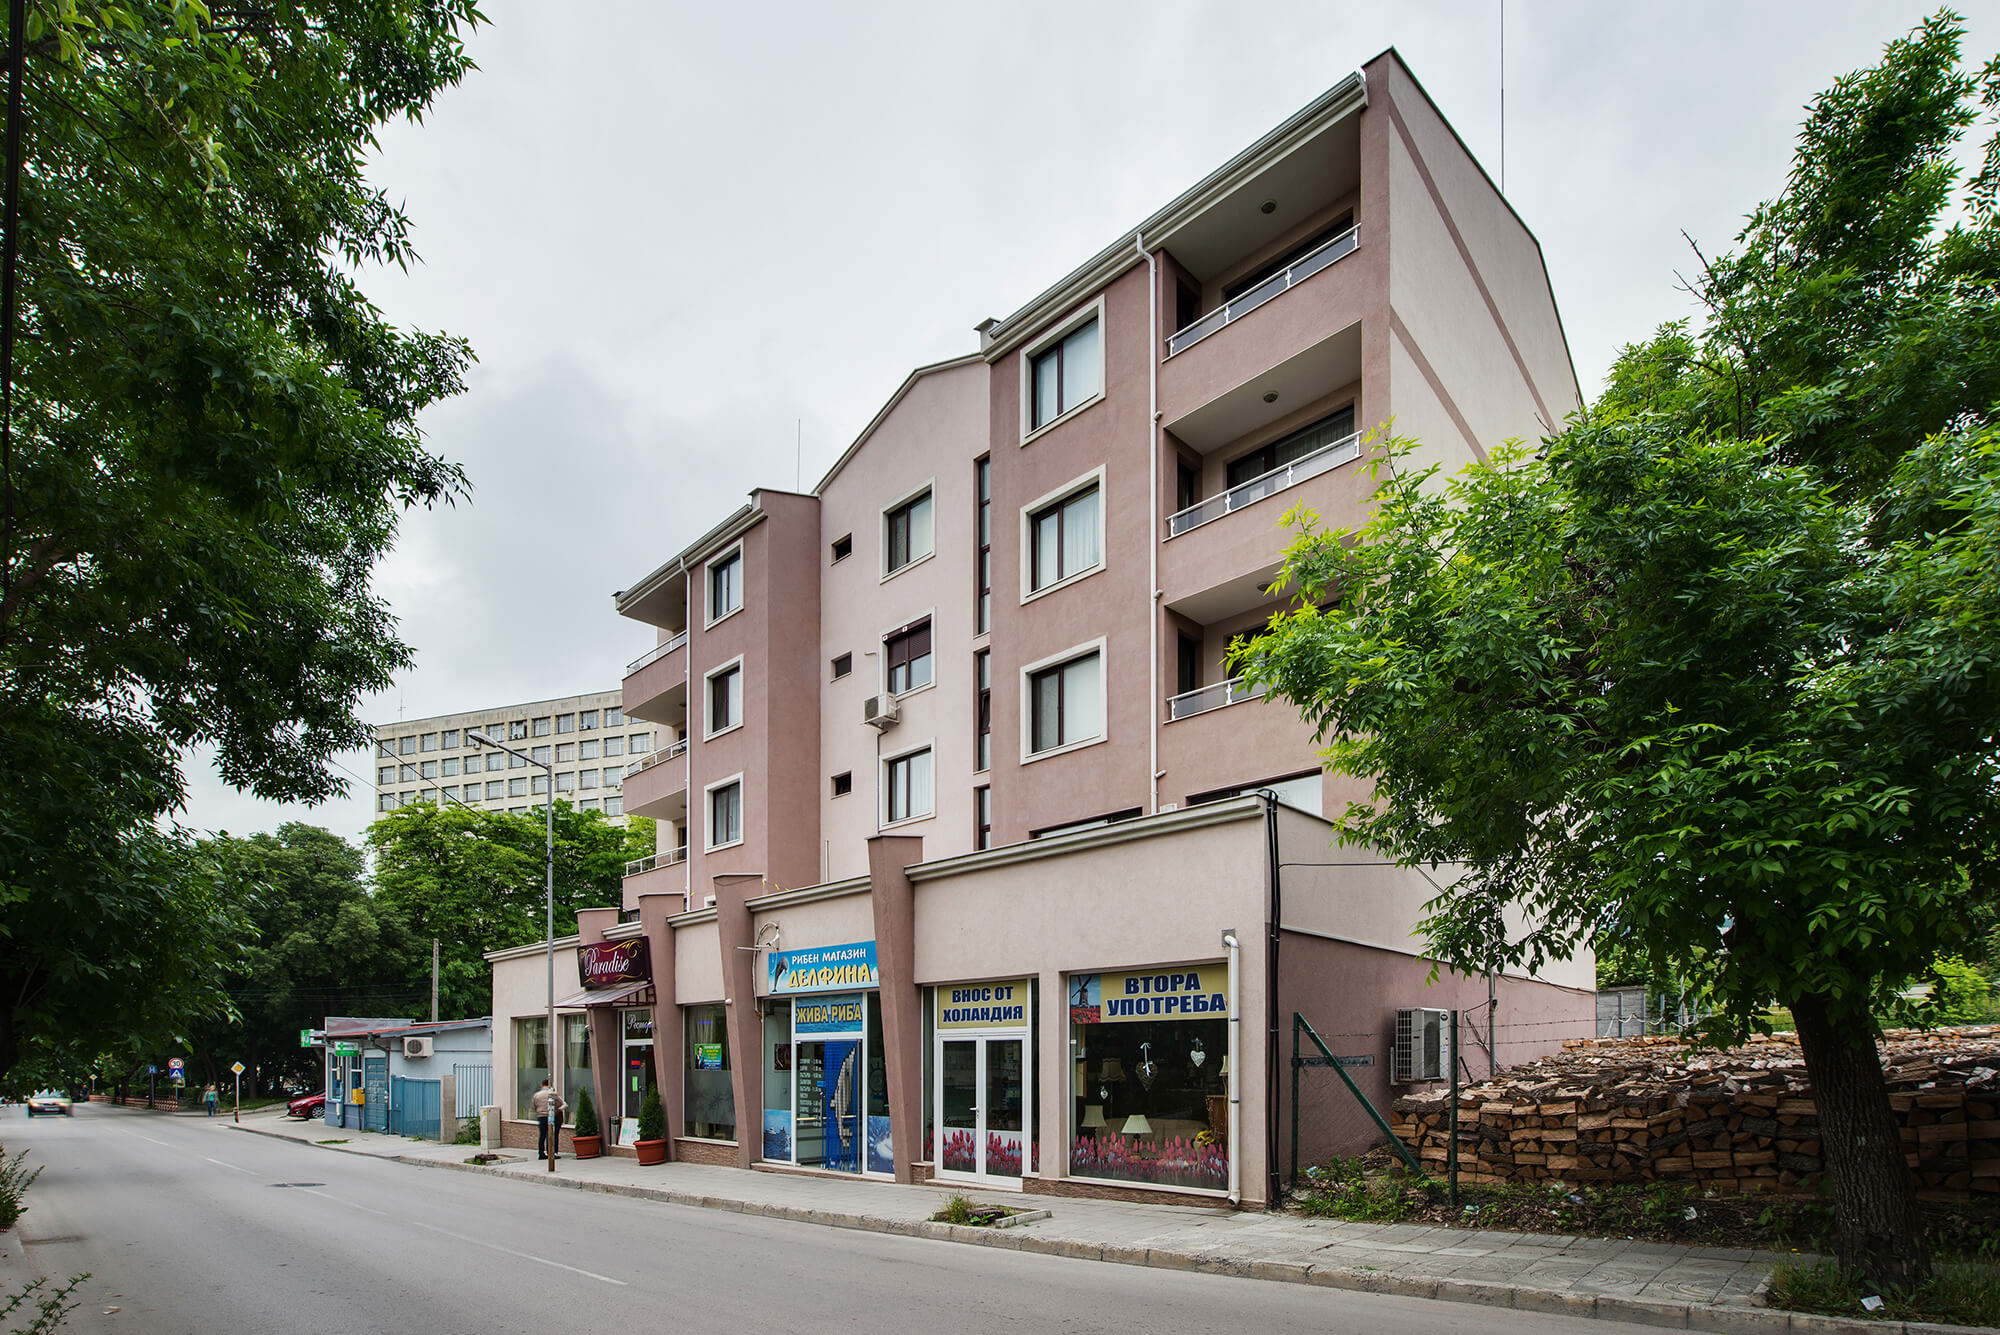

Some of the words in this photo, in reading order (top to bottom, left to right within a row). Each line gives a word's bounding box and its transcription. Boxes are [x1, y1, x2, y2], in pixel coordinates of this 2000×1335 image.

[584, 947, 630, 977] Paradise
[792, 953, 820, 965] РИБЕН
[822, 948, 867, 962] МАГАЗИН
[788, 963, 873, 988] ДЕЛФИНА
[1125, 973, 1201, 995] ВТОРА
[952, 987, 991, 1003] ВНОС
[995, 986, 1014, 1001] ОТ
[1107, 993, 1227, 1017] УПОТРЕБА
[796, 1006, 829, 1024] ЖИВА
[831, 1003, 862, 1022] РИБА
[943, 1005, 1023, 1022] ХОЛАНДИЯ
